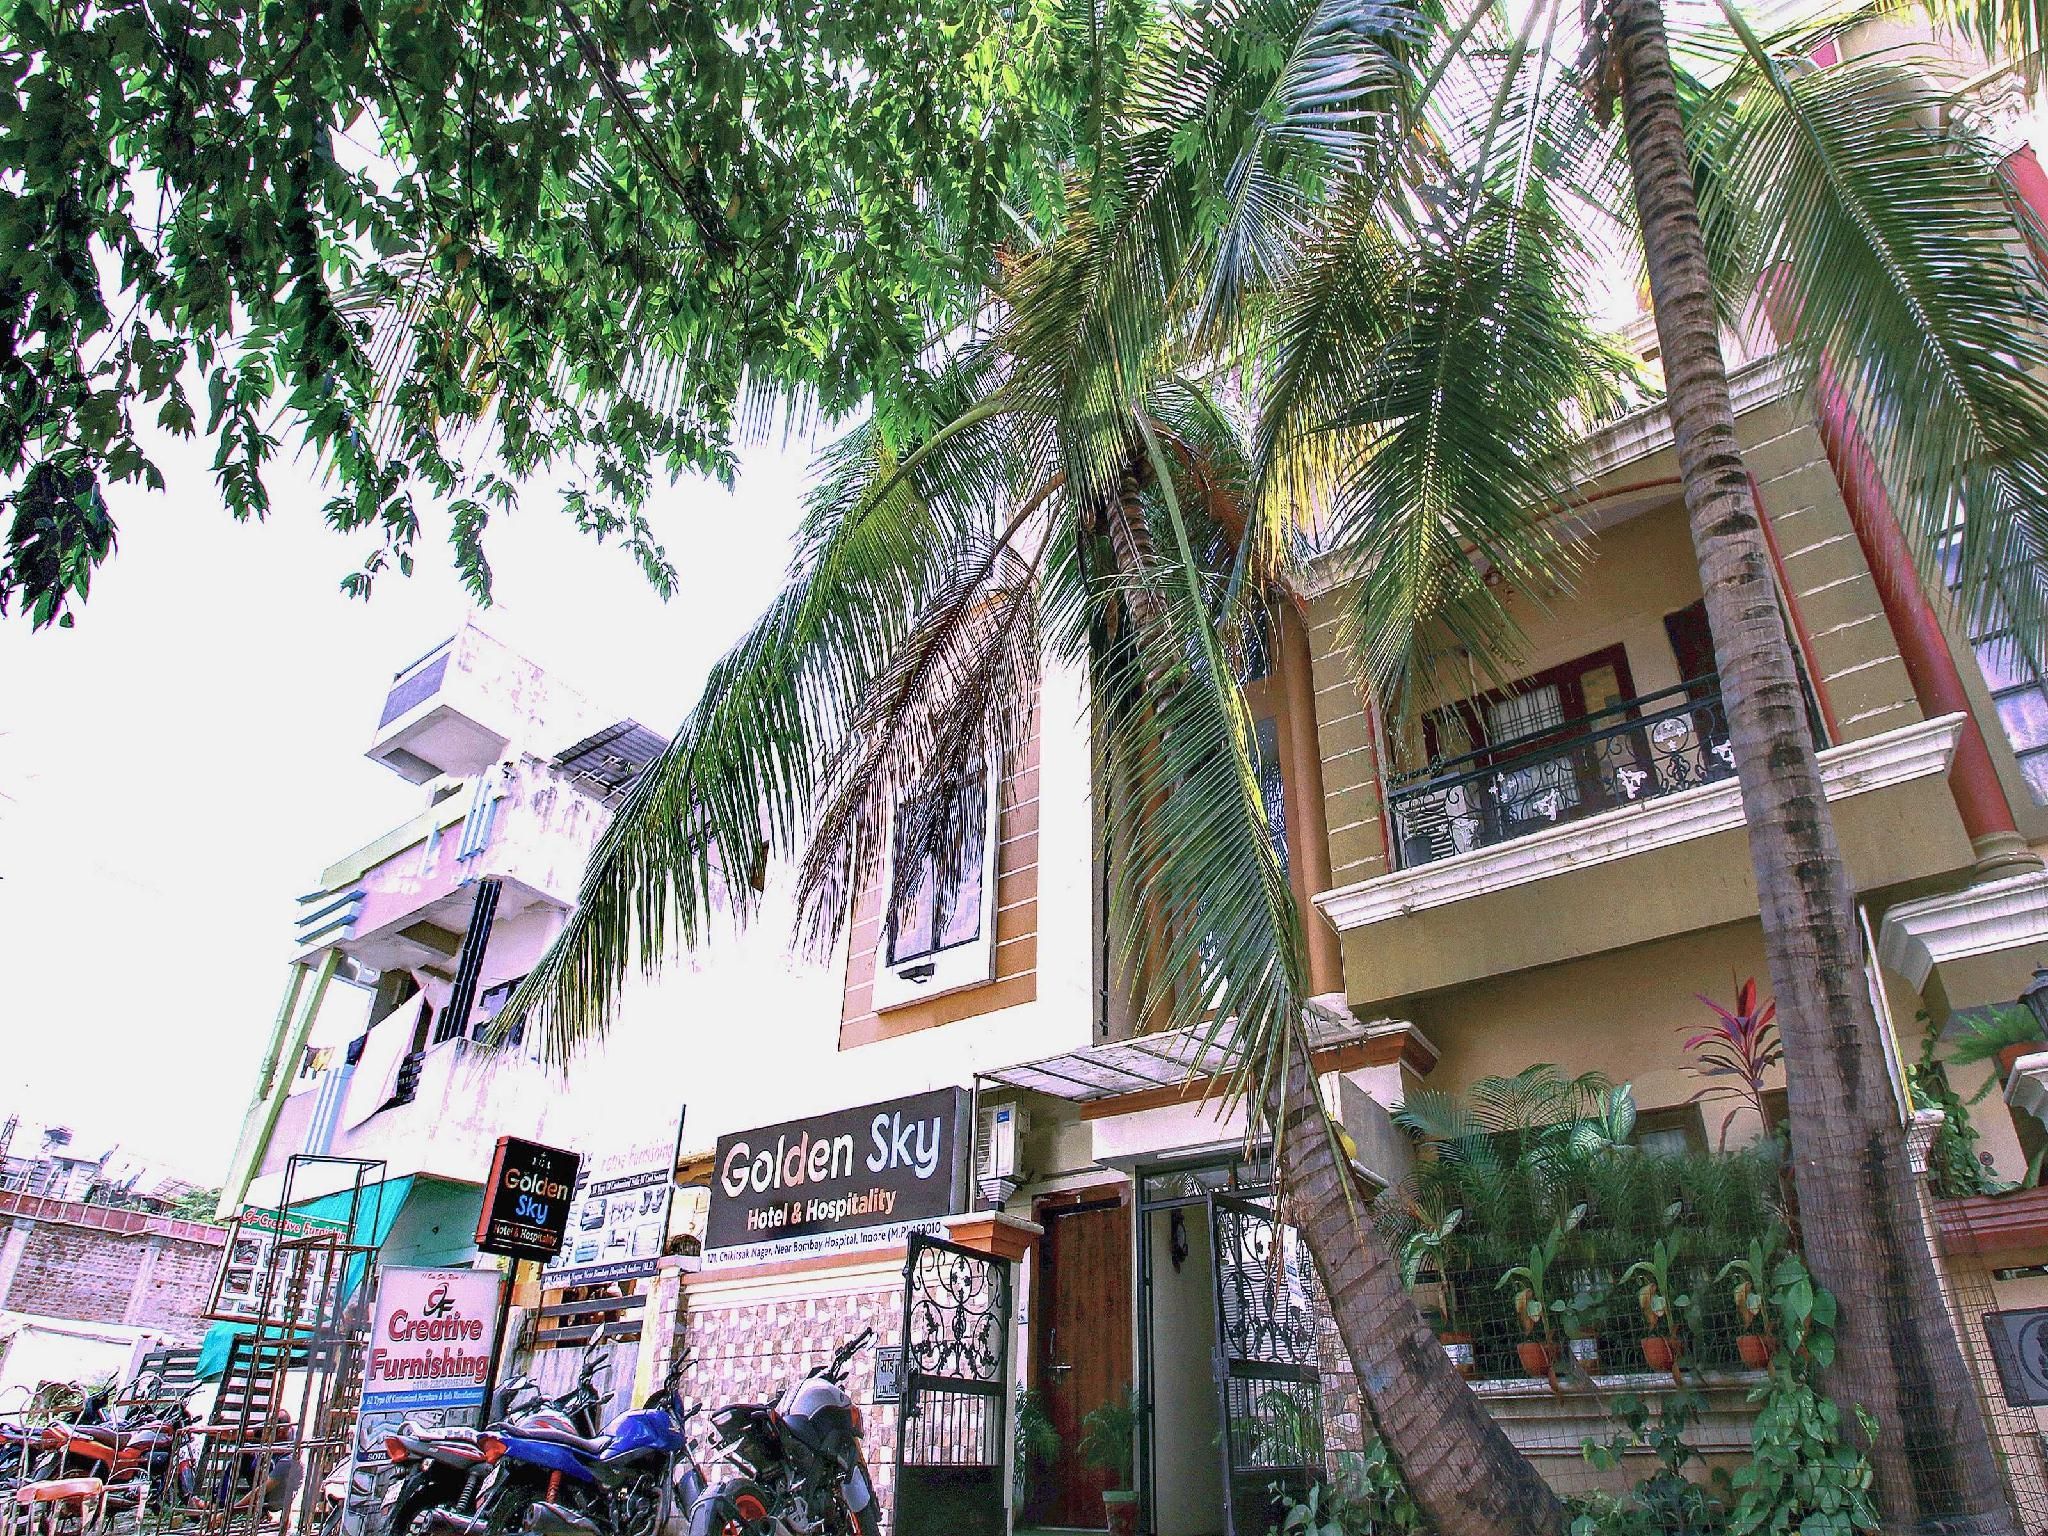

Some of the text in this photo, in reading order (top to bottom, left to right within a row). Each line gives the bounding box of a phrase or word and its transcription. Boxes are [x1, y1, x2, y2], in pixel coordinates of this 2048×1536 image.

[721, 1111, 941, 1198] Golden Sky
[504, 1168, 568, 1201] Golden
[515, 1194, 549, 1225] Sky
[747, 1187, 897, 1231] Hotel & Hospitality
[493, 1222, 512, 1236] Hotel
[519, 1228, 558, 1247] Hospitality
[774, 1242, 791, 1255] Near
[793, 1238, 823, 1253] Bombay
[860, 1231, 887, 1244] Indore
[388, 1309, 484, 1341] Creative
[369, 1347, 490, 1384] Furnishing
[374, 1396, 386, 1407] Type
